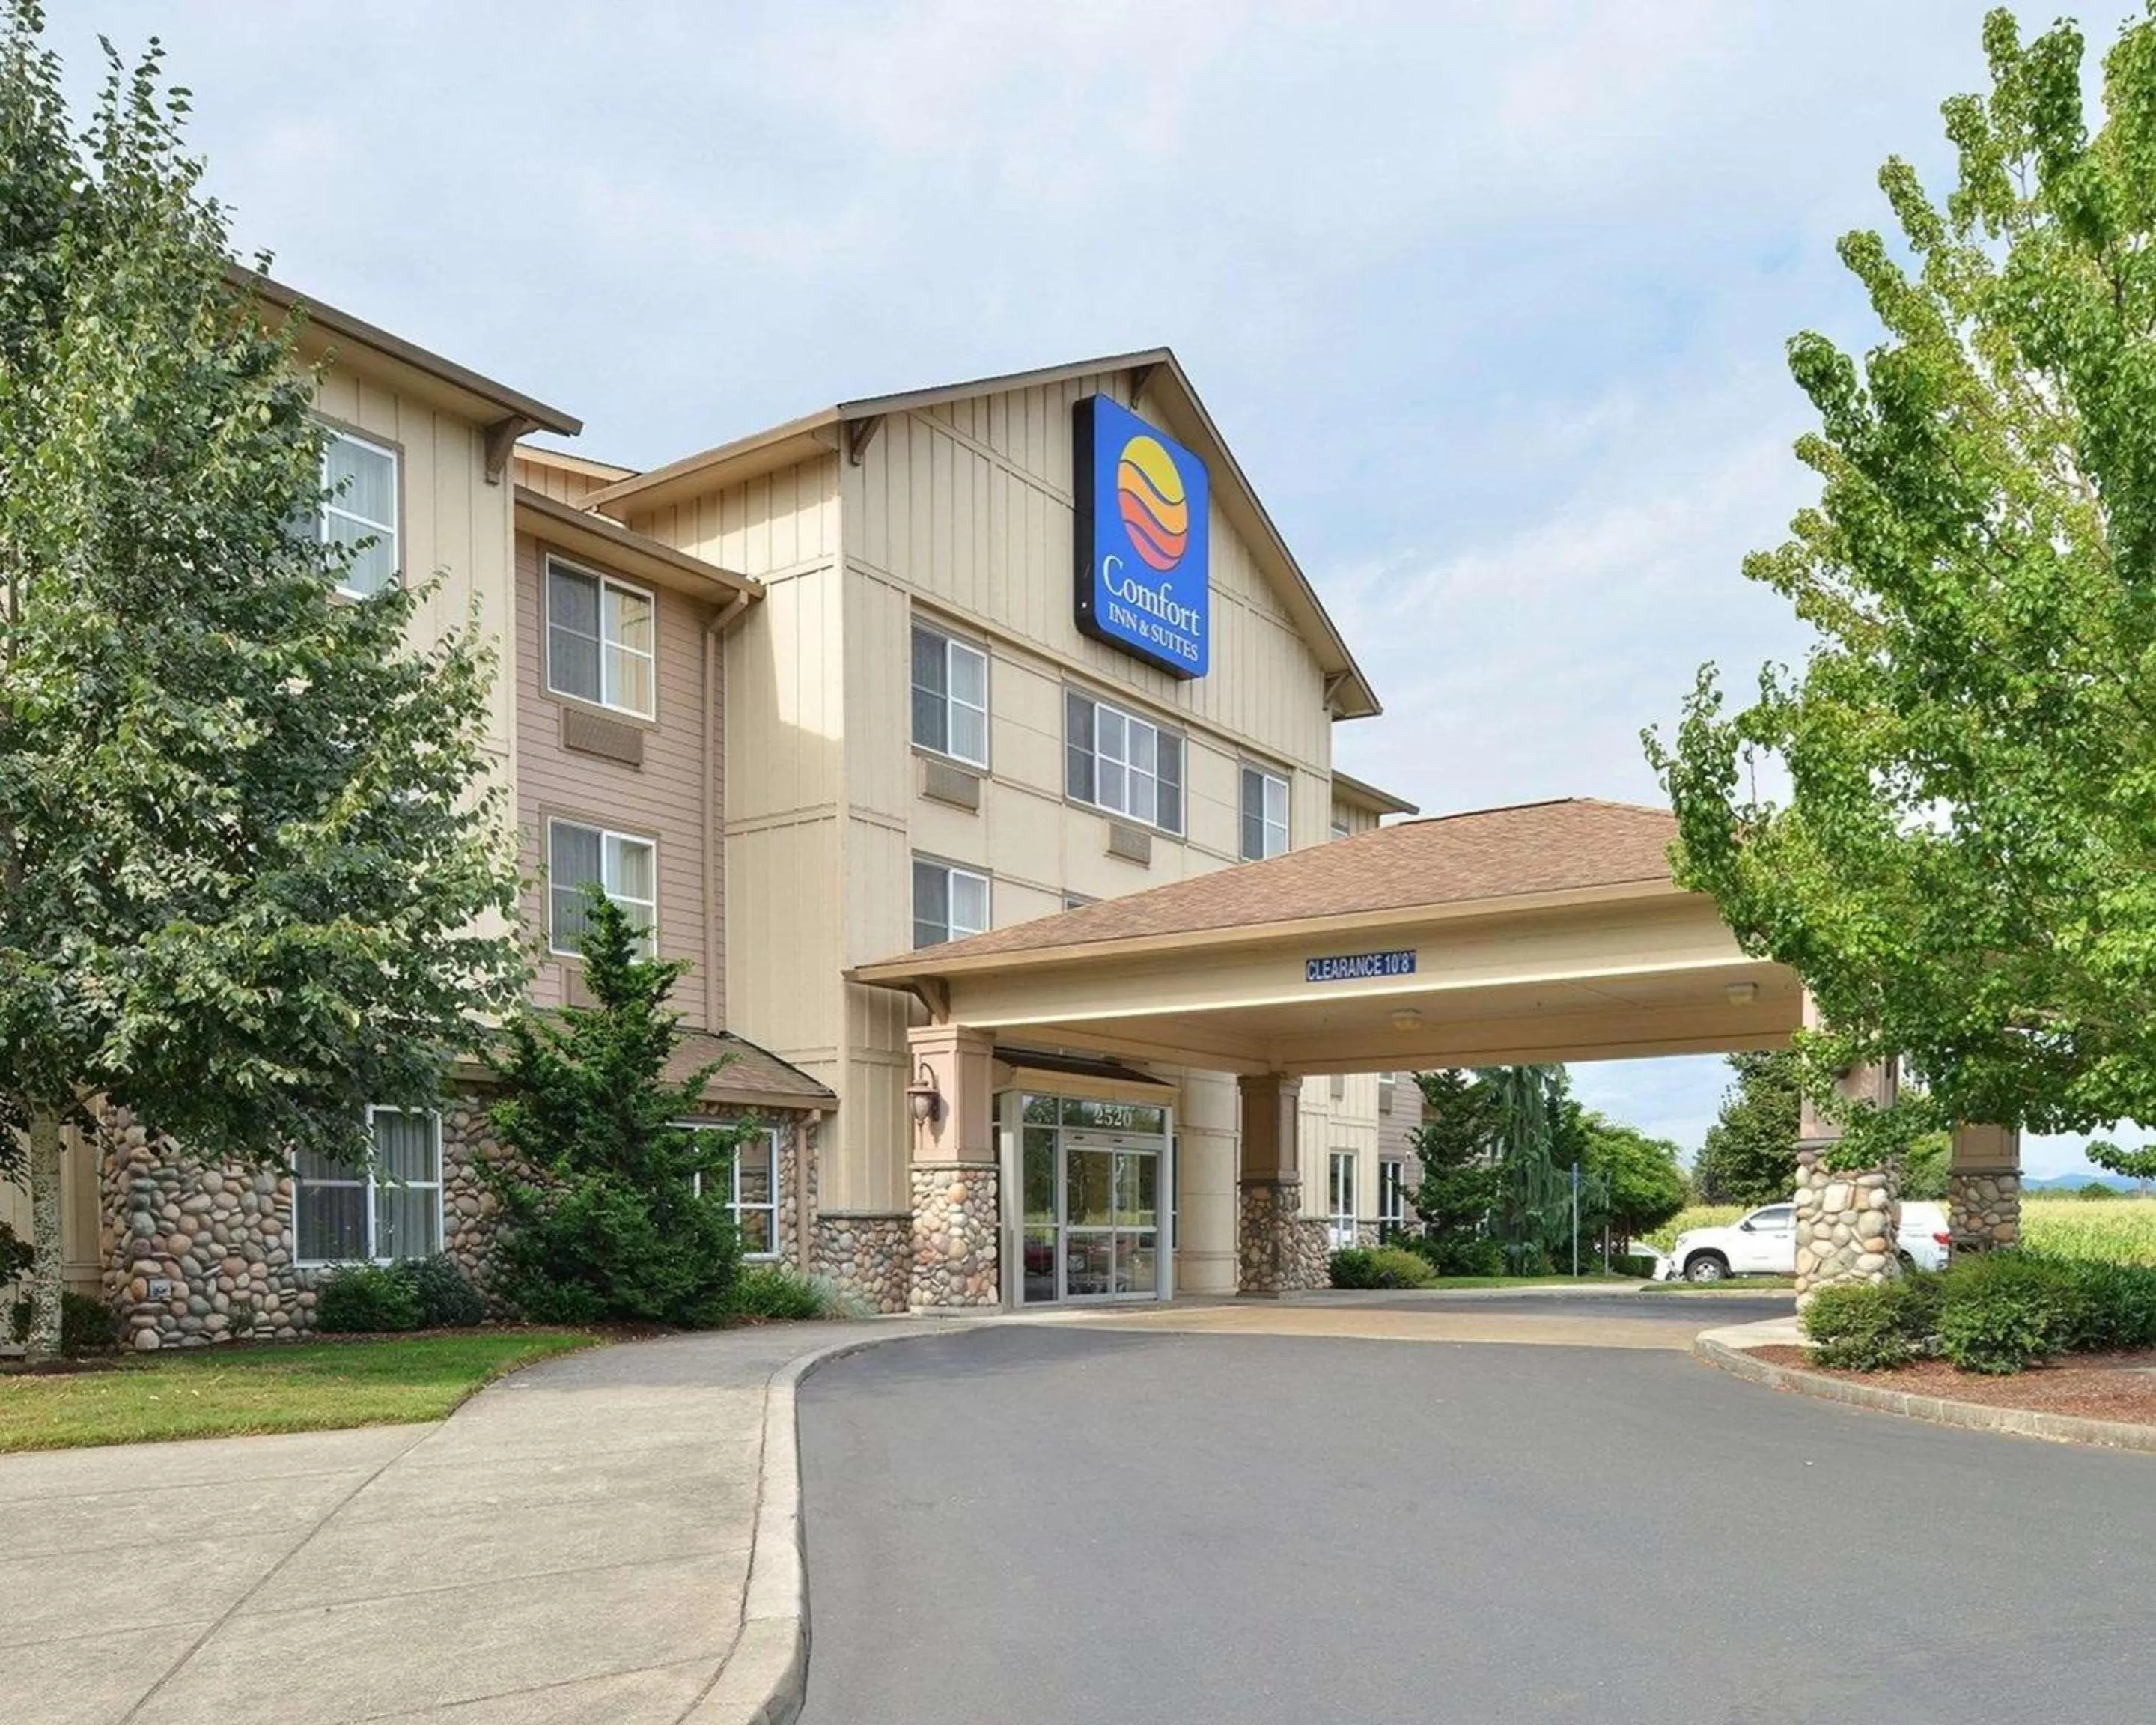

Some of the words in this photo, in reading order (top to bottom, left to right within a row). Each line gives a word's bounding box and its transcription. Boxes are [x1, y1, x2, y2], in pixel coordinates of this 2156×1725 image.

[1103, 555, 1201, 636] Comfort
[1108, 601, 1138, 632] INN
[1139, 619, 1151, 638] &
[1151, 624, 1198, 662] SUITES
[1307, 954, 1382, 980] CLEARANCE
[1094, 1107, 1132, 1128] 2520
